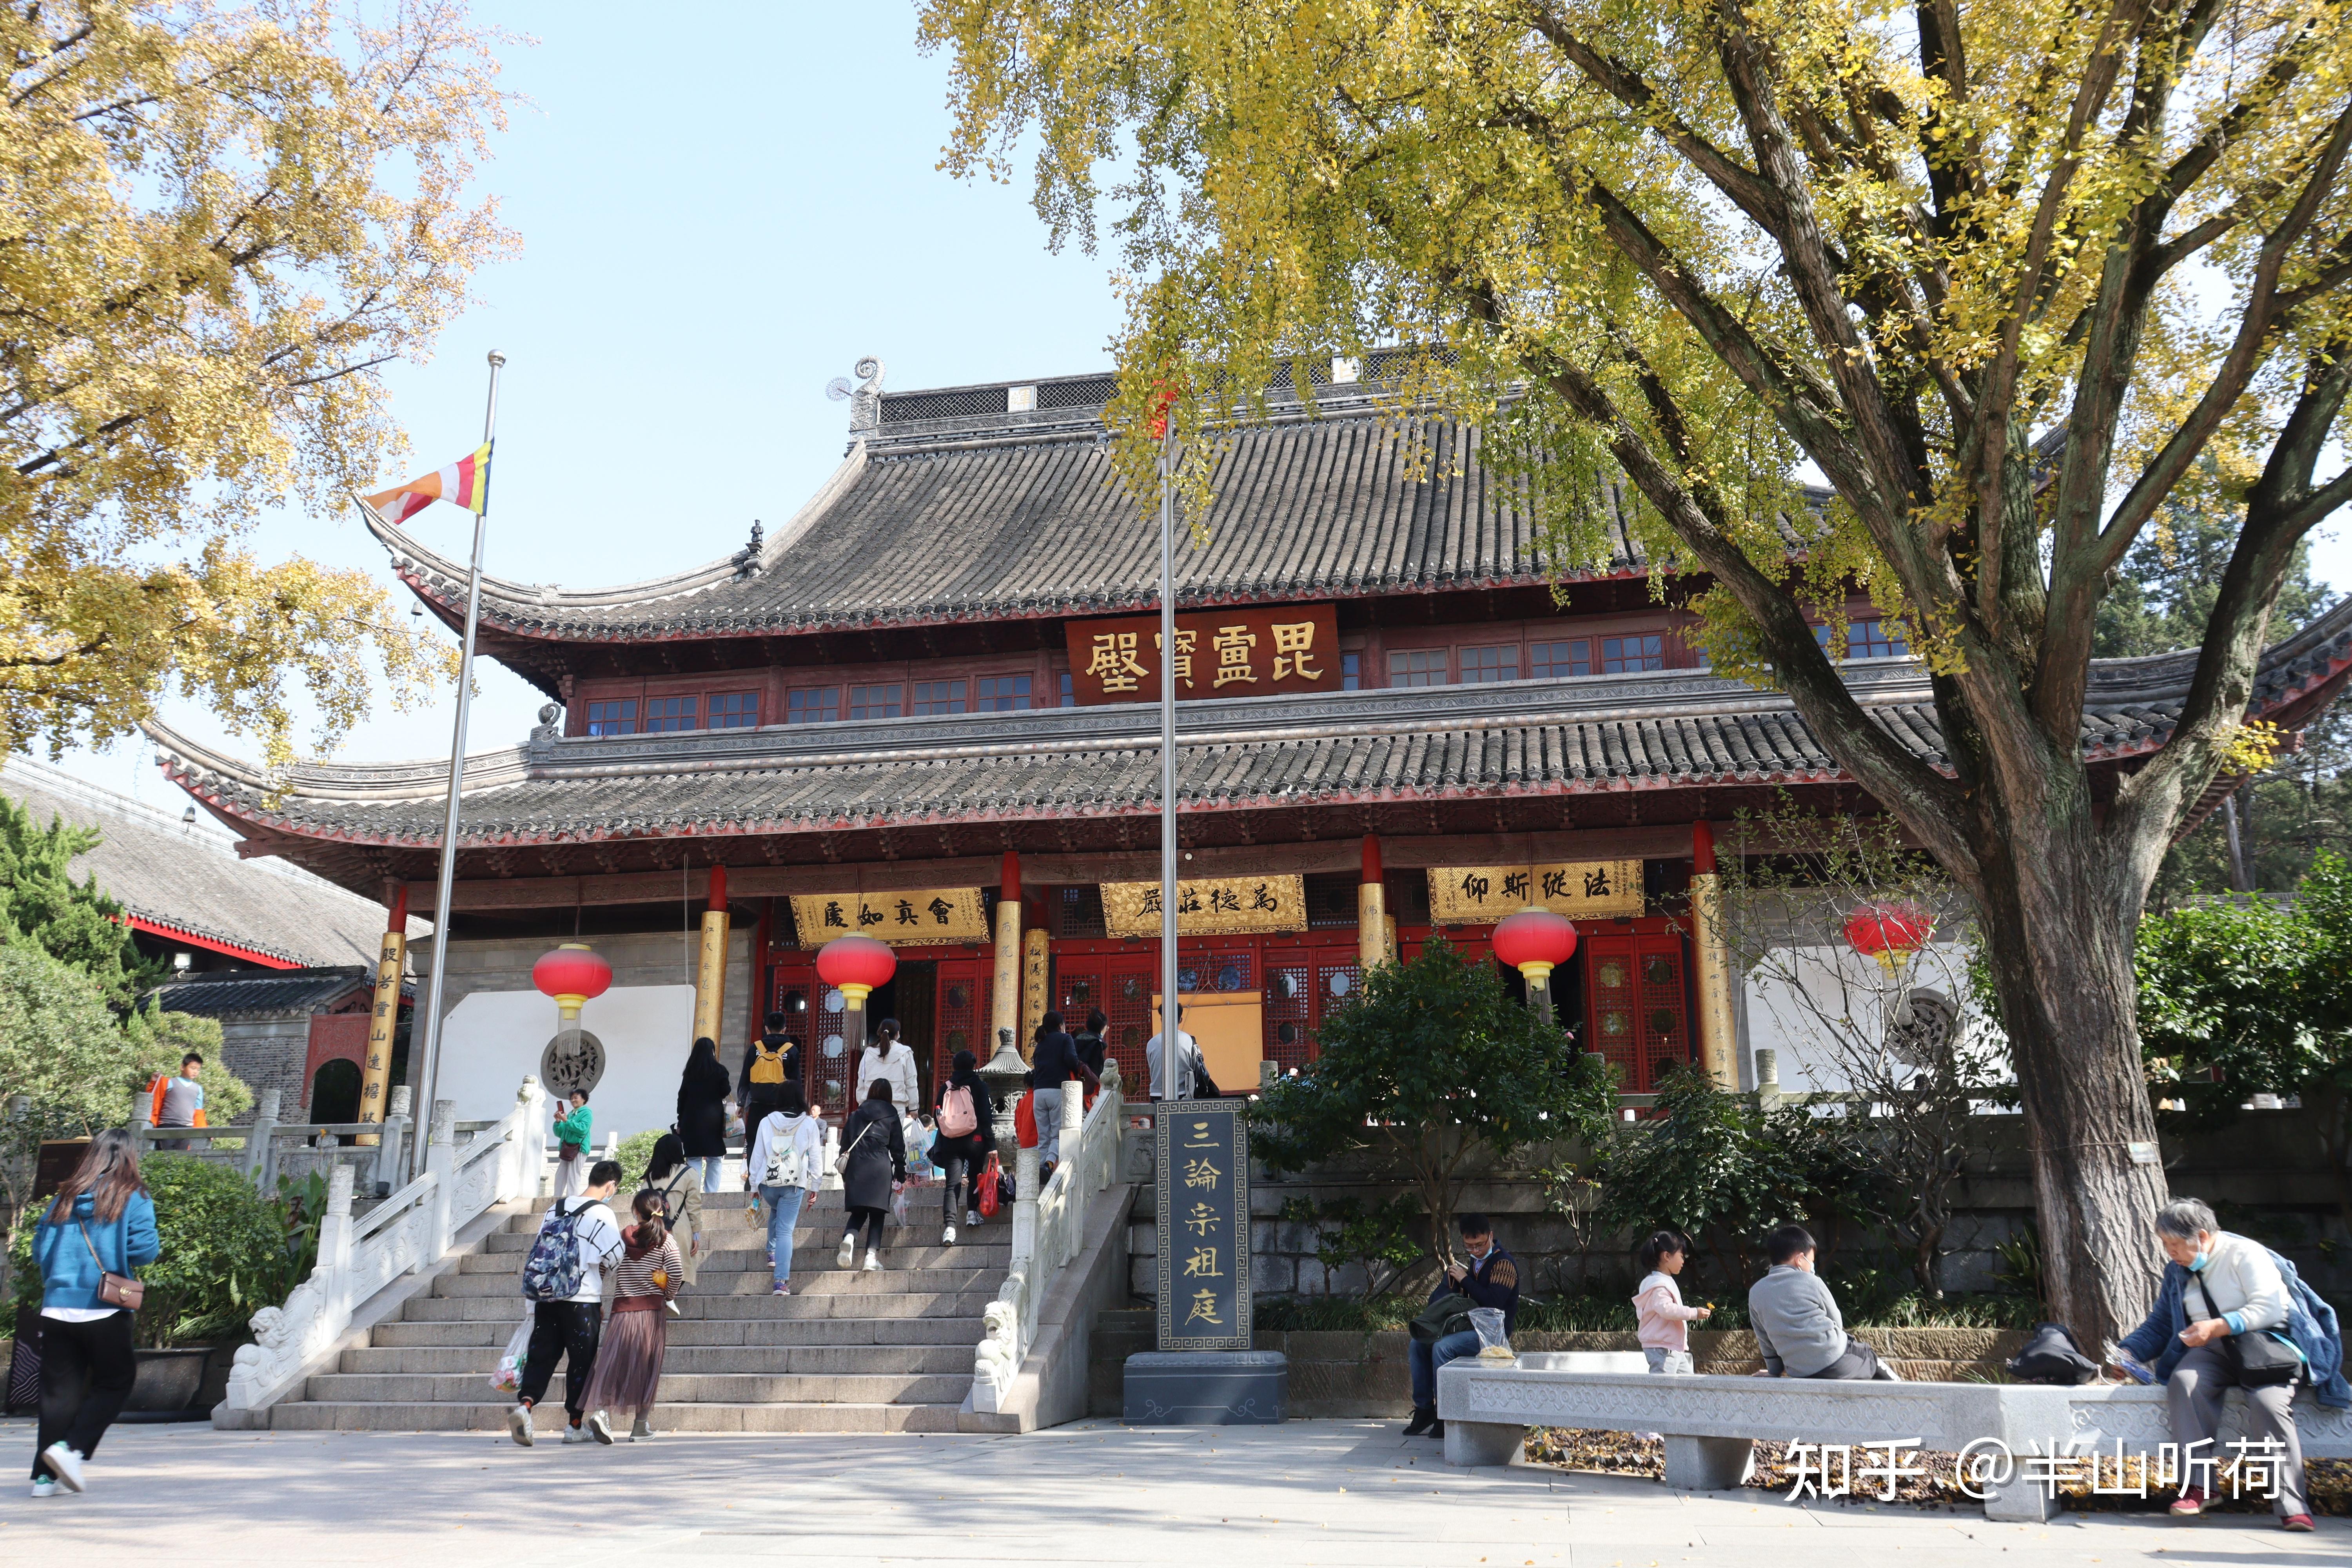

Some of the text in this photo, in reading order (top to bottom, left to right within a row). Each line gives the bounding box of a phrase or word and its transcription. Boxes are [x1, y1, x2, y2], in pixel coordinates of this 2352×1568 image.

[1183, 1122, 1223, 1326] 三論宗祖庭
